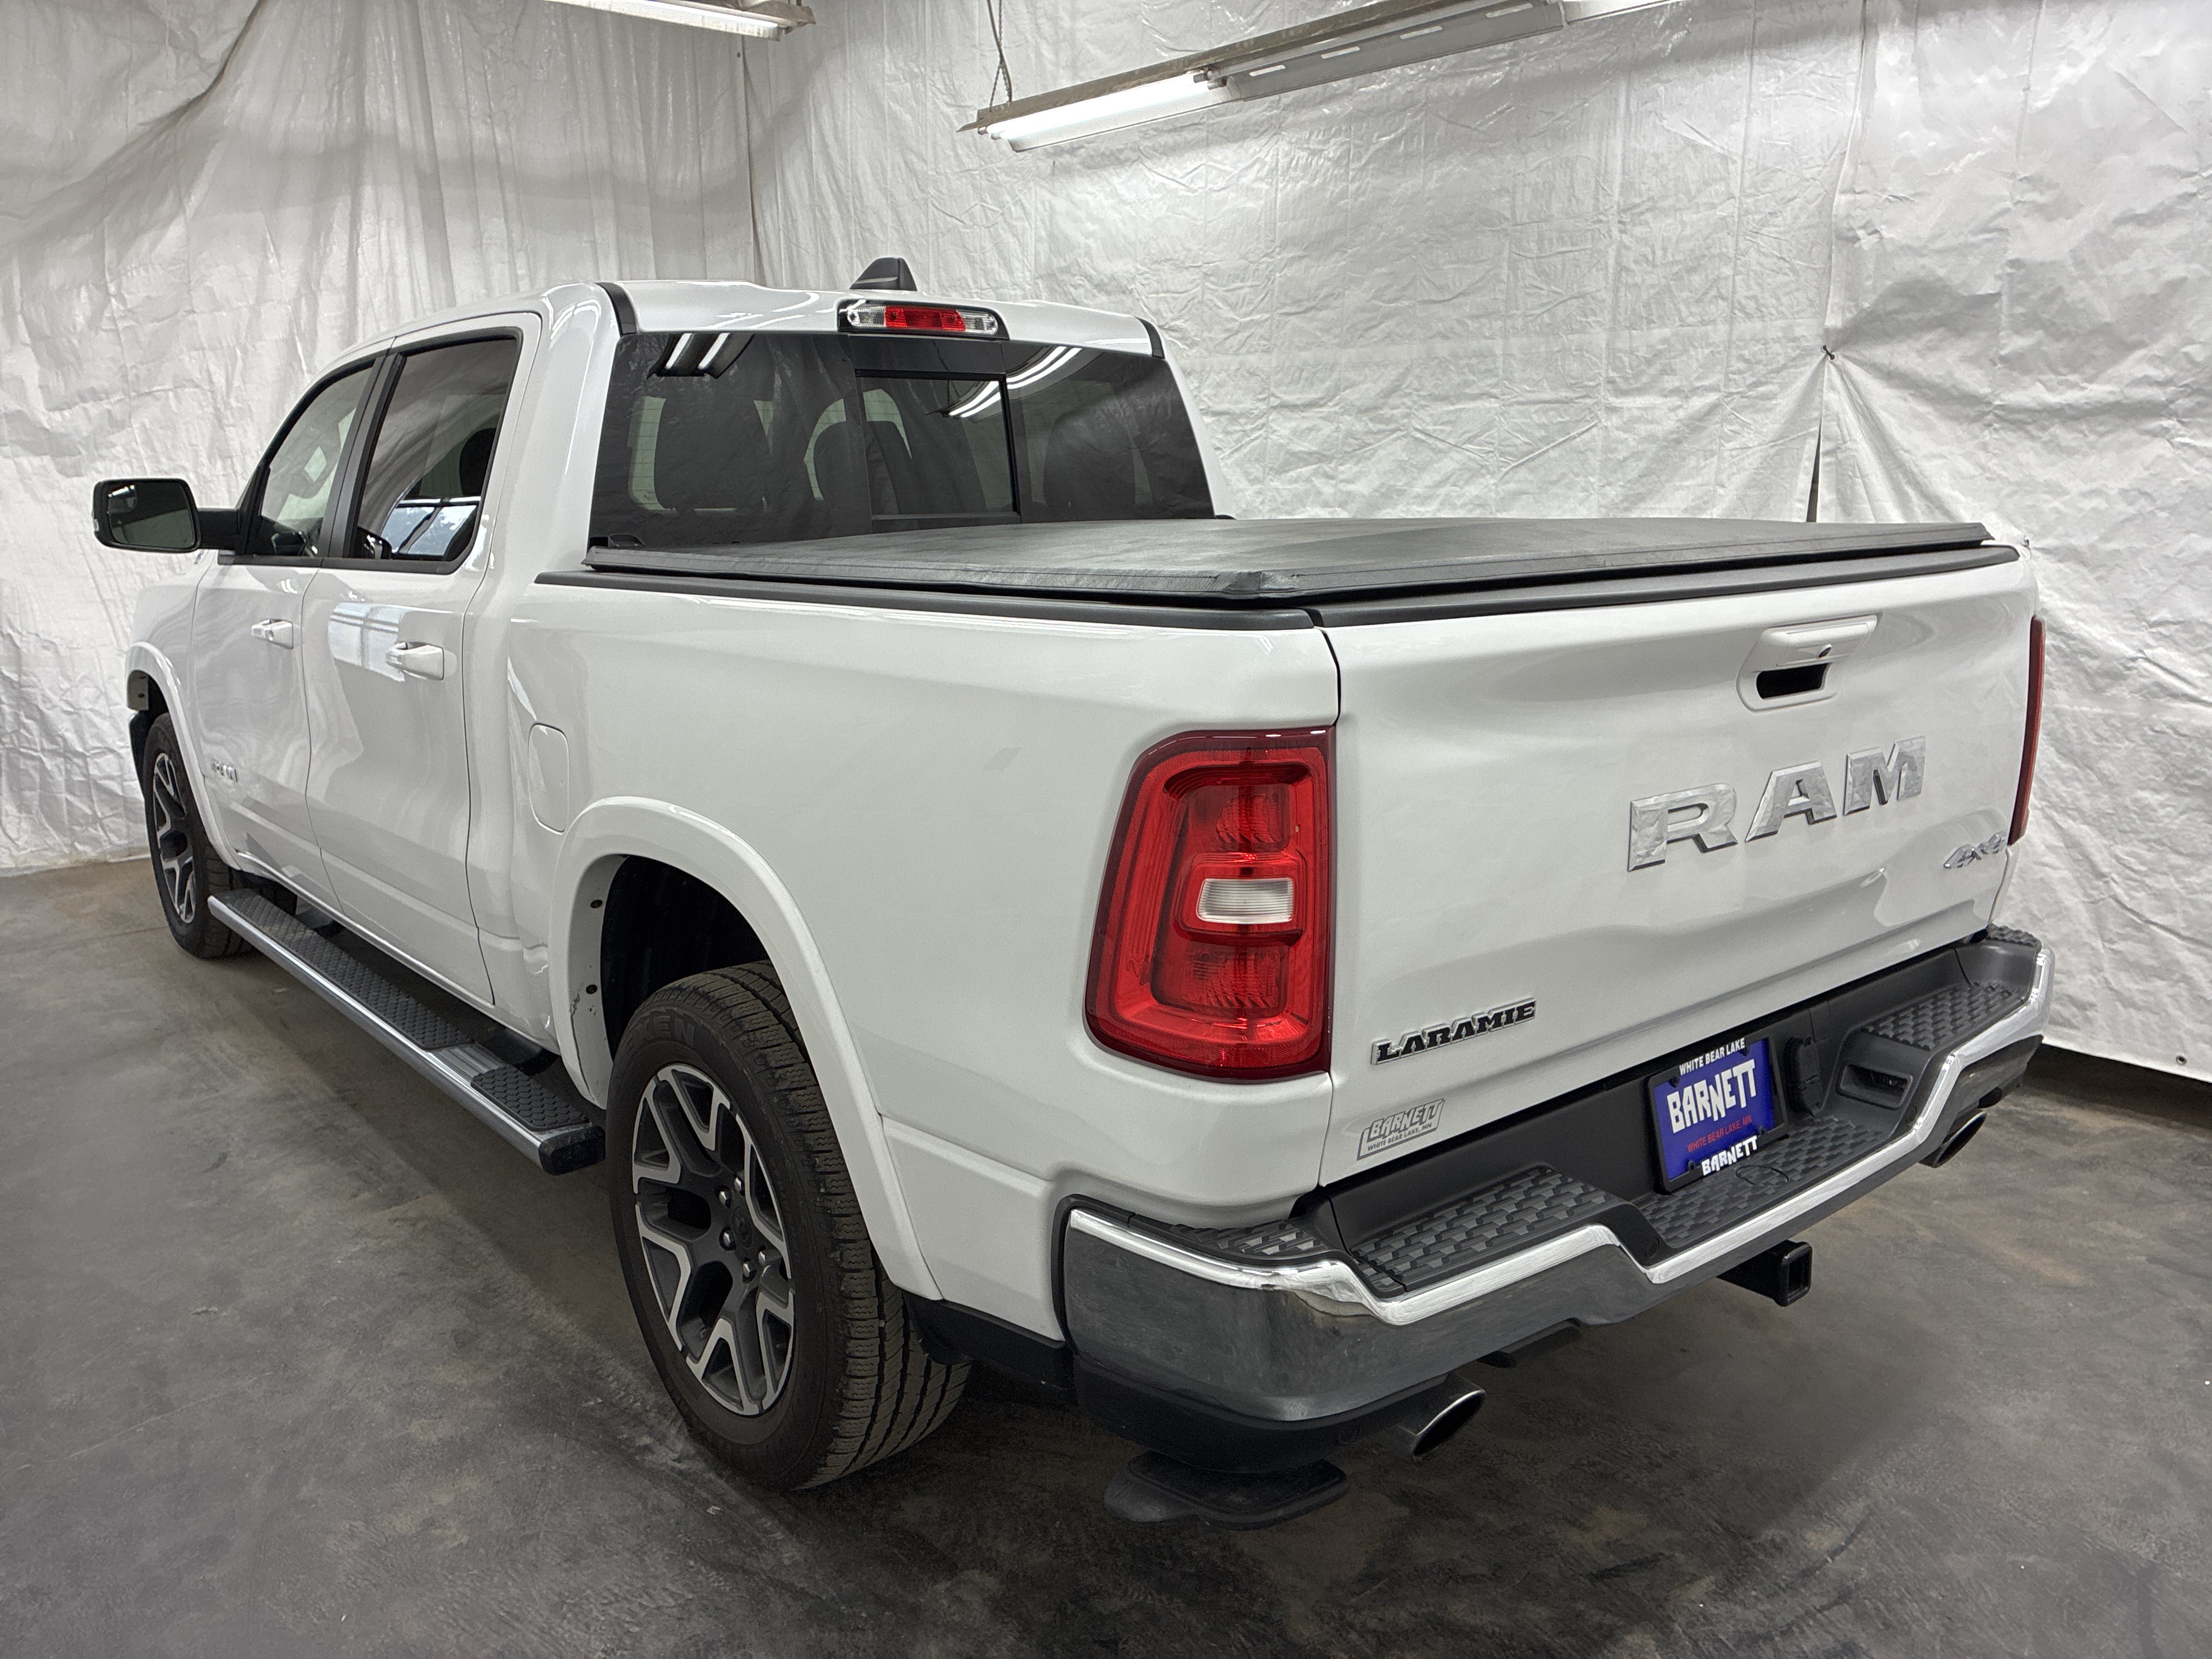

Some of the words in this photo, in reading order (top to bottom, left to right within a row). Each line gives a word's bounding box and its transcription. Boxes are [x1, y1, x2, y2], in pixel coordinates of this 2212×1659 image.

[1627, 736, 1926, 872] RAM
[1371, 997, 1537, 1065] LARAMIE
[1679, 1055, 1704, 1076] WHITE
[1705, 1046, 1725, 1065] BEAR
[1726, 1037, 1745, 1056] LAKE
[1667, 1059, 1757, 1133] BARNETT
[1367, 1098, 1444, 1143] BARNETT
[1368, 1139, 1386, 1152] WHITE
[1388, 1133, 1403, 1144] BEAR
[1421, 1122, 1432, 1132] MN
[1687, 1136, 1707, 1153] WHITE
[1707, 1128, 1724, 1143] BEAR
[1701, 1135, 1757, 1176] BARNETT
